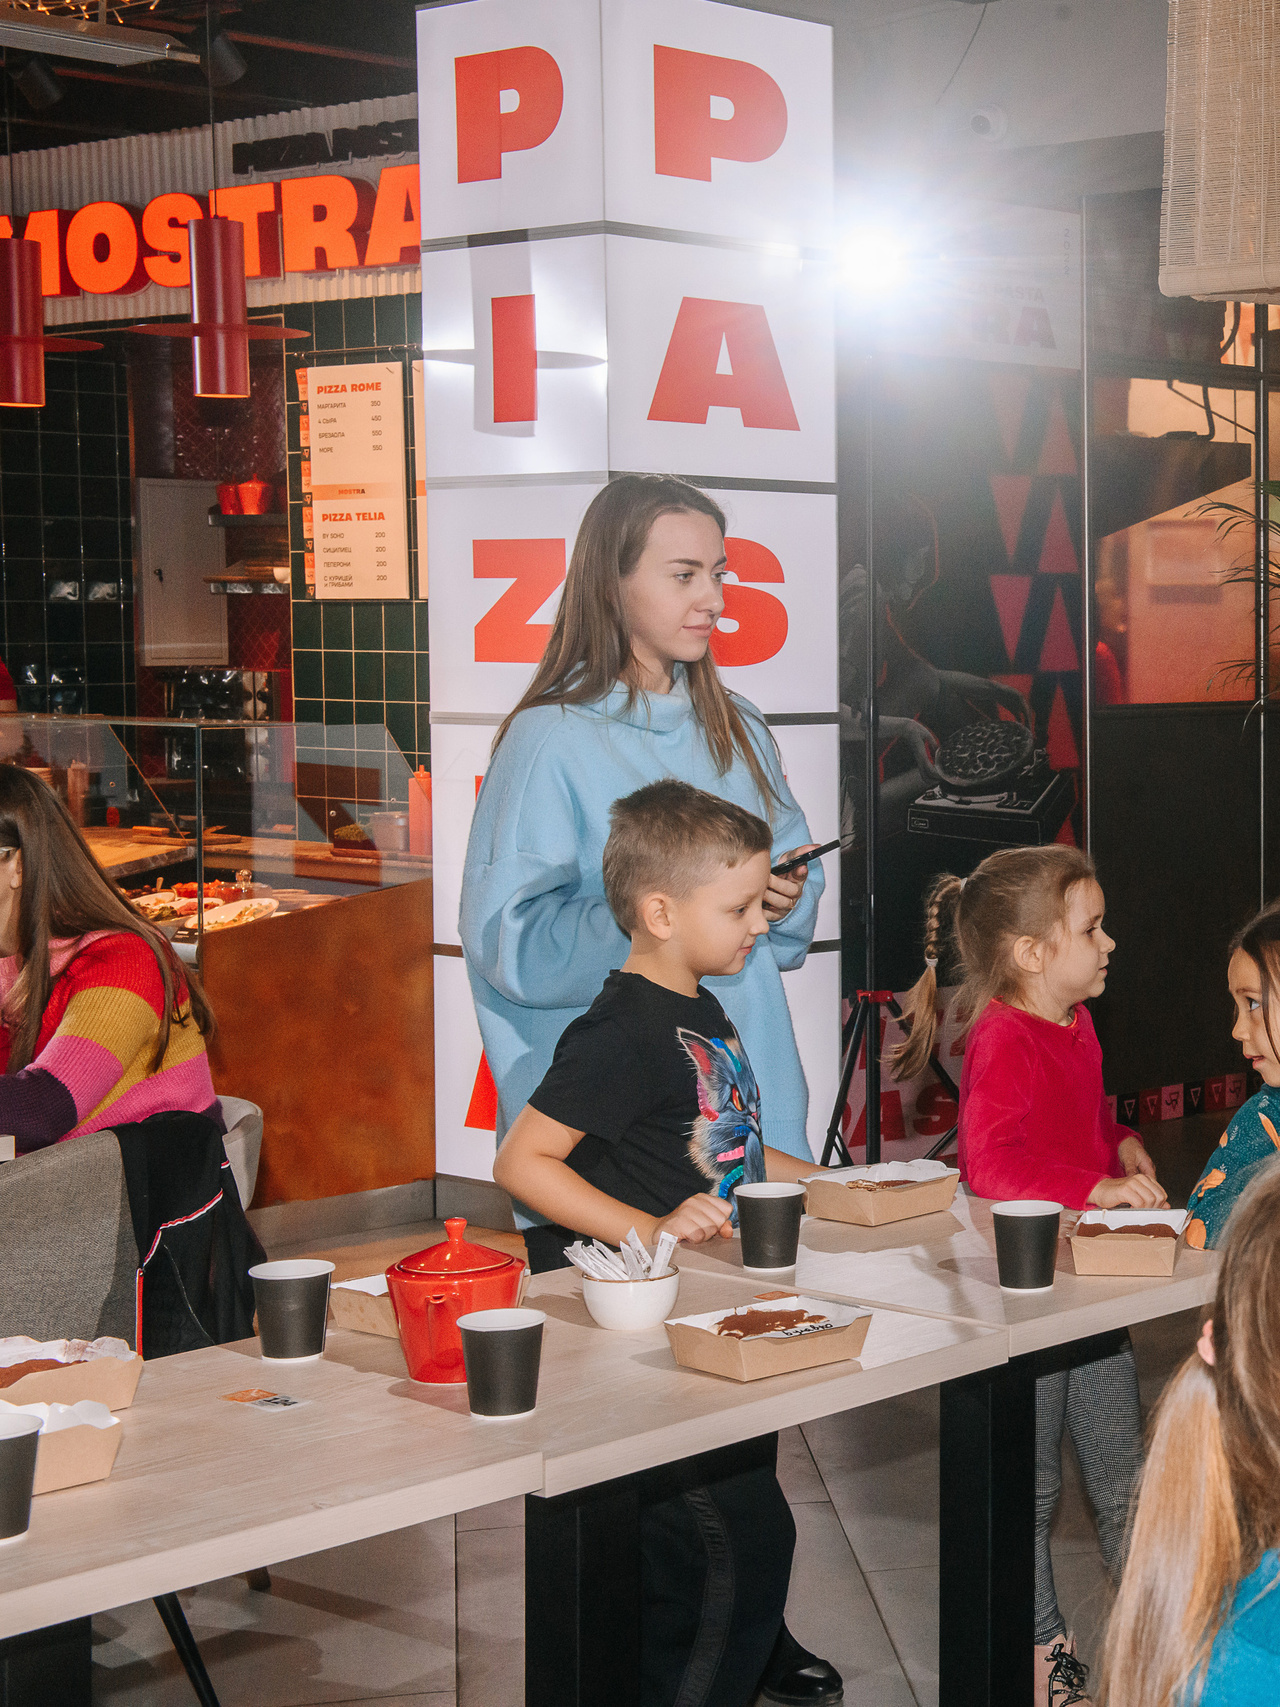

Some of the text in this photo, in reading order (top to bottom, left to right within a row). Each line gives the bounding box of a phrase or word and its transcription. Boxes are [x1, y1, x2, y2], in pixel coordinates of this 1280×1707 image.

[317, 382, 382, 394] PIZZA ROME
[321, 512, 385, 522] PIZZA TELIA
